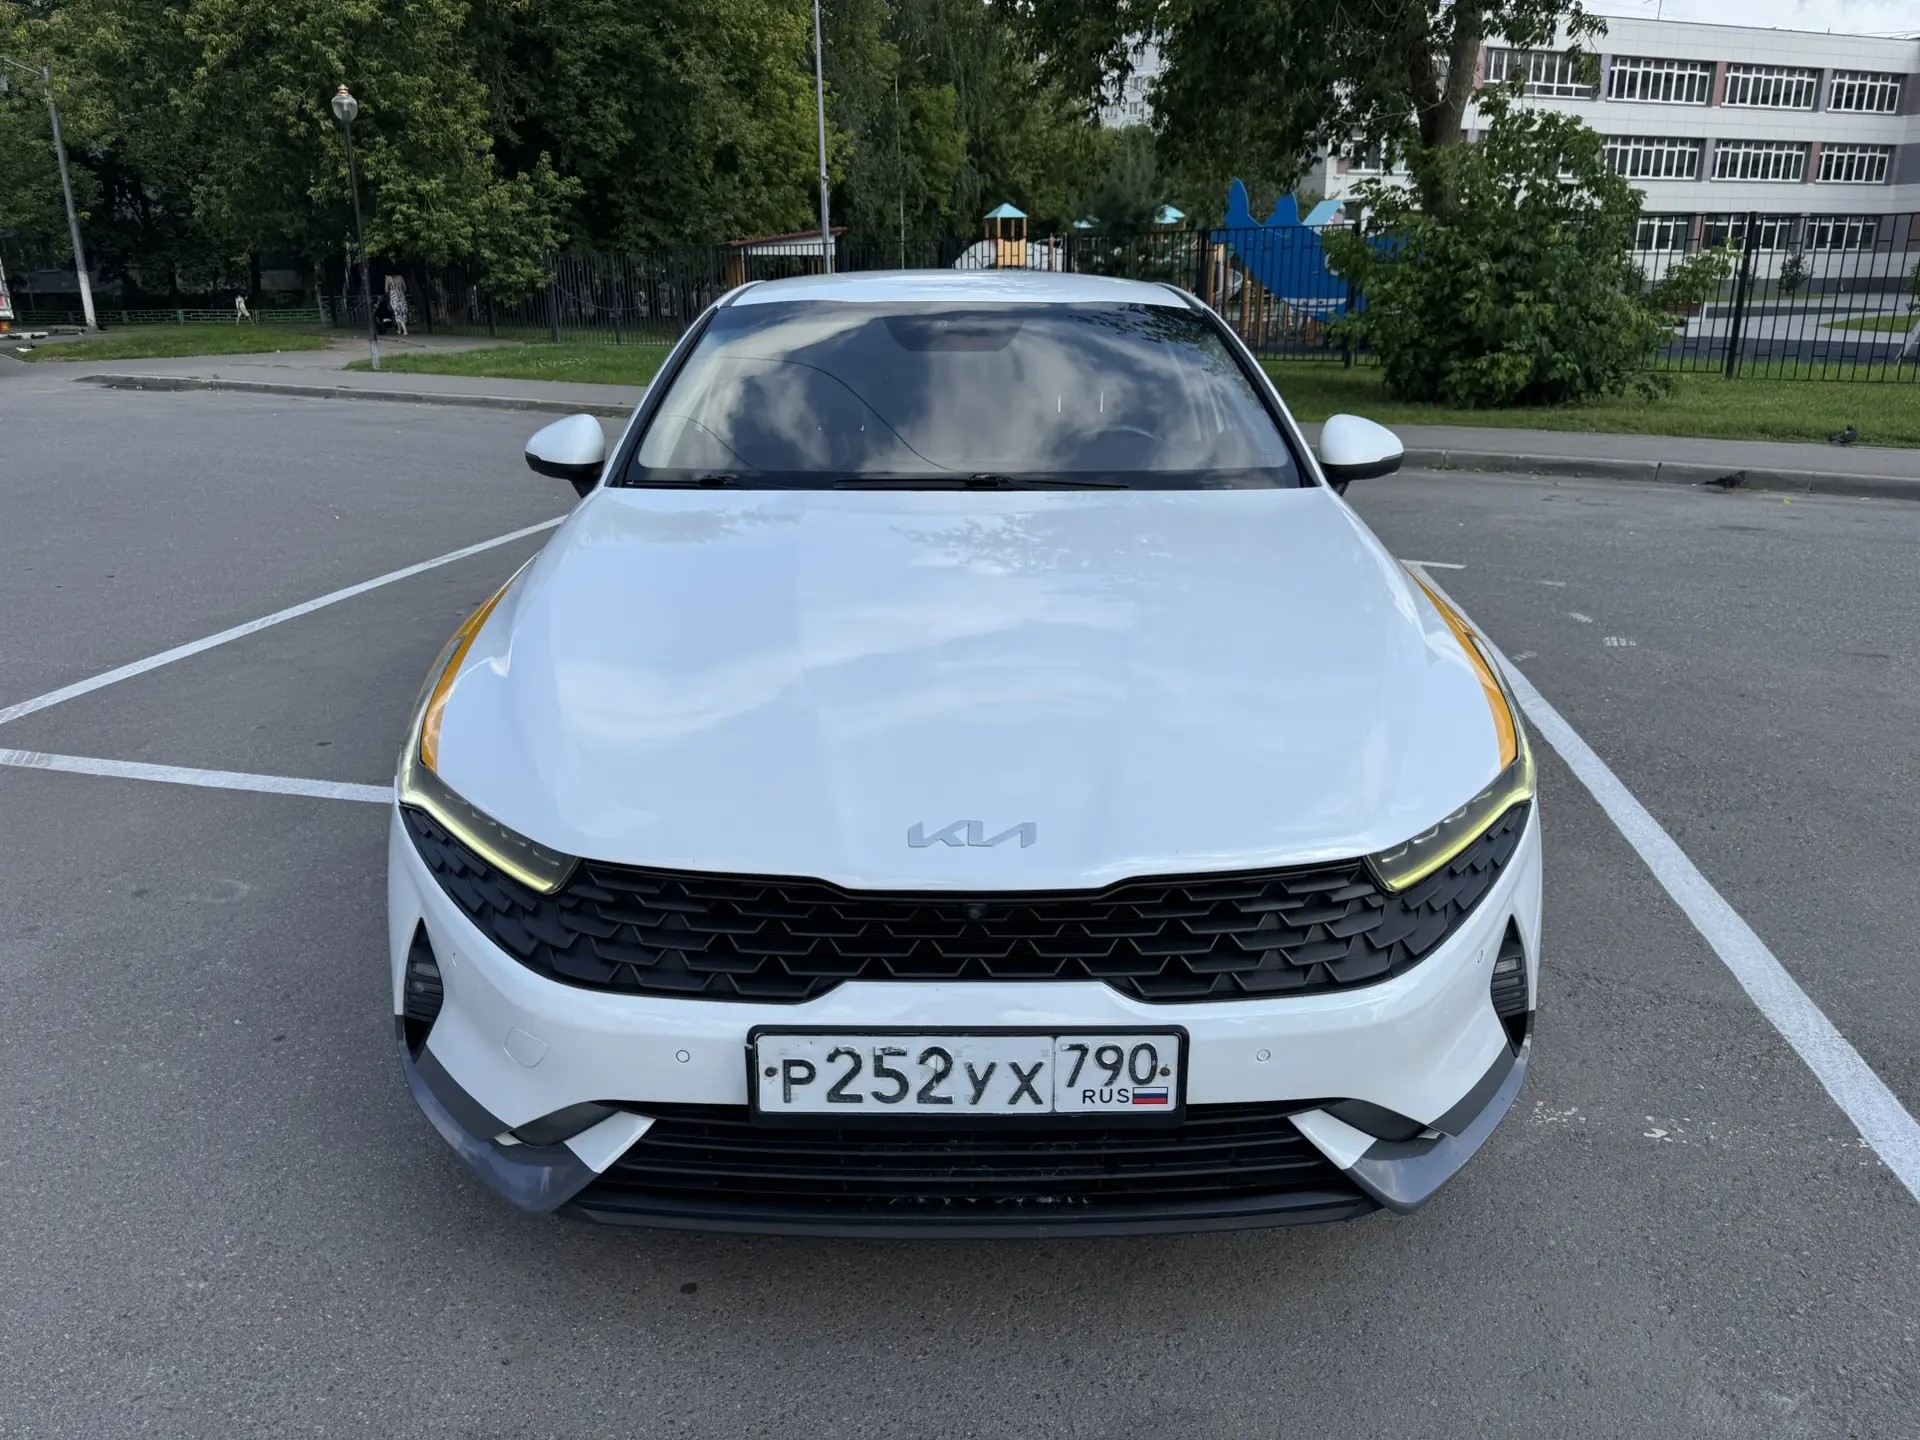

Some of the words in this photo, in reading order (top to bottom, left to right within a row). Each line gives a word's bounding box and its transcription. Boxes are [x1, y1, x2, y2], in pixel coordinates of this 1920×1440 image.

[907, 819, 1037, 848] KIA
[1060, 1042, 1159, 1088] 790
[1082, 1088, 1131, 1104] RUS
